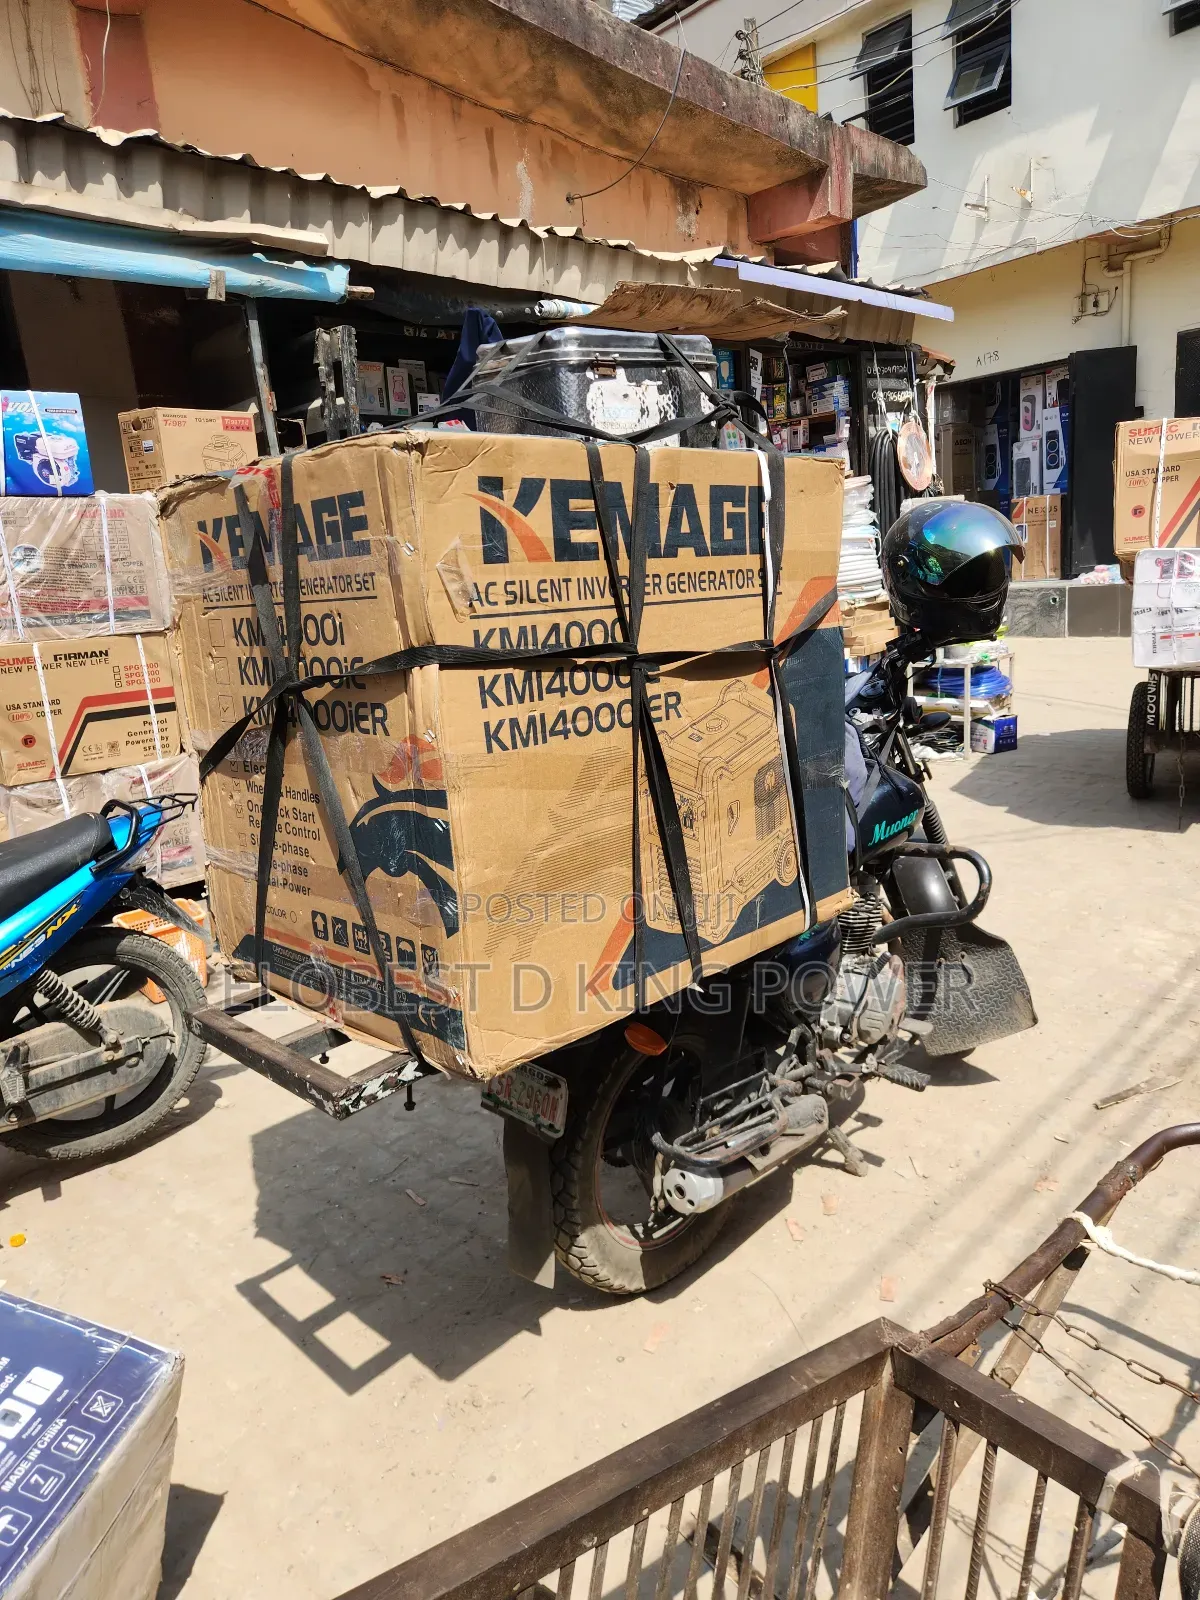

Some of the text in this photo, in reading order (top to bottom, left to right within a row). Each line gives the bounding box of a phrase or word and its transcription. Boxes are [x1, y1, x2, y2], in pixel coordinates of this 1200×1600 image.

[1128, 436, 1153, 446] NEW
[1125, 469, 1140, 477] USA
[1152, 475, 1179, 484] CPPER
[355, 572, 376, 593] SET
[503, 578, 572, 605] SILENT
[666, 568, 756, 594] GENERATOR
[0, 649, 109, 667] SUME FIRMAN
[0, 666, 22, 674] NEW
[66, 660, 86, 668] NEW
[90, 657, 110, 665] LIFE
[6, 703, 21, 711] USA
[1146, 672, 1158, 726] SHADOW
[11, 709, 62, 721] 100% COPER
[143, 718, 168, 727] Perol
[285, 785, 320, 804] Handles
[292, 807, 316, 824] Start
[285, 821, 321, 842] Control
[1, 1459, 32, 1492] MADE
[30, 1447, 42, 1462] IN
[37, 1418, 67, 1449] CHINA
